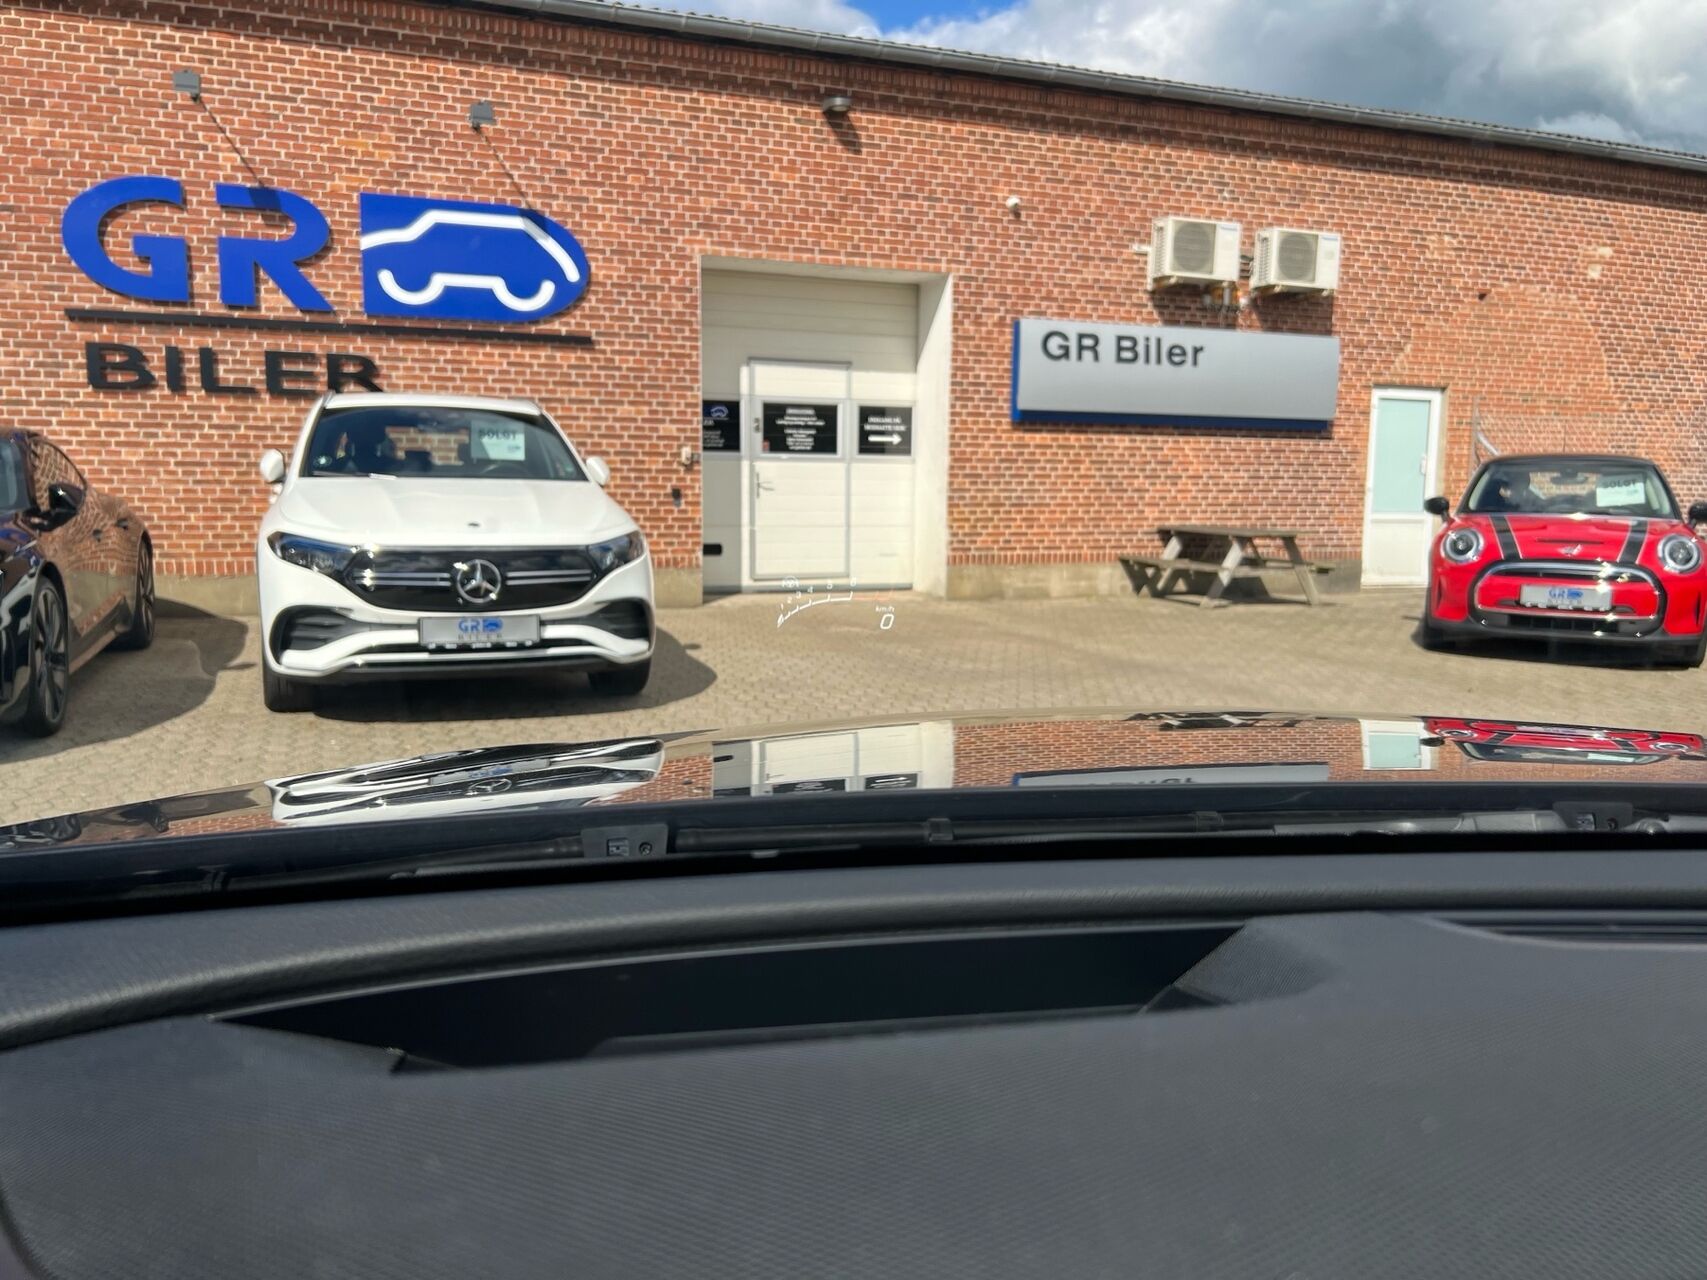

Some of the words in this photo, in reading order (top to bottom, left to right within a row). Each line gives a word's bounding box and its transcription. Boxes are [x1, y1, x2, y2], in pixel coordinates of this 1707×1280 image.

[62, 175, 333, 313] GR
[1041, 330, 1100, 363] GR
[1115, 334, 1204, 367] Biler
[84, 341, 384, 397] BILER
[458, 619, 481, 632] GR
[880, 613, 895, 630] 0
